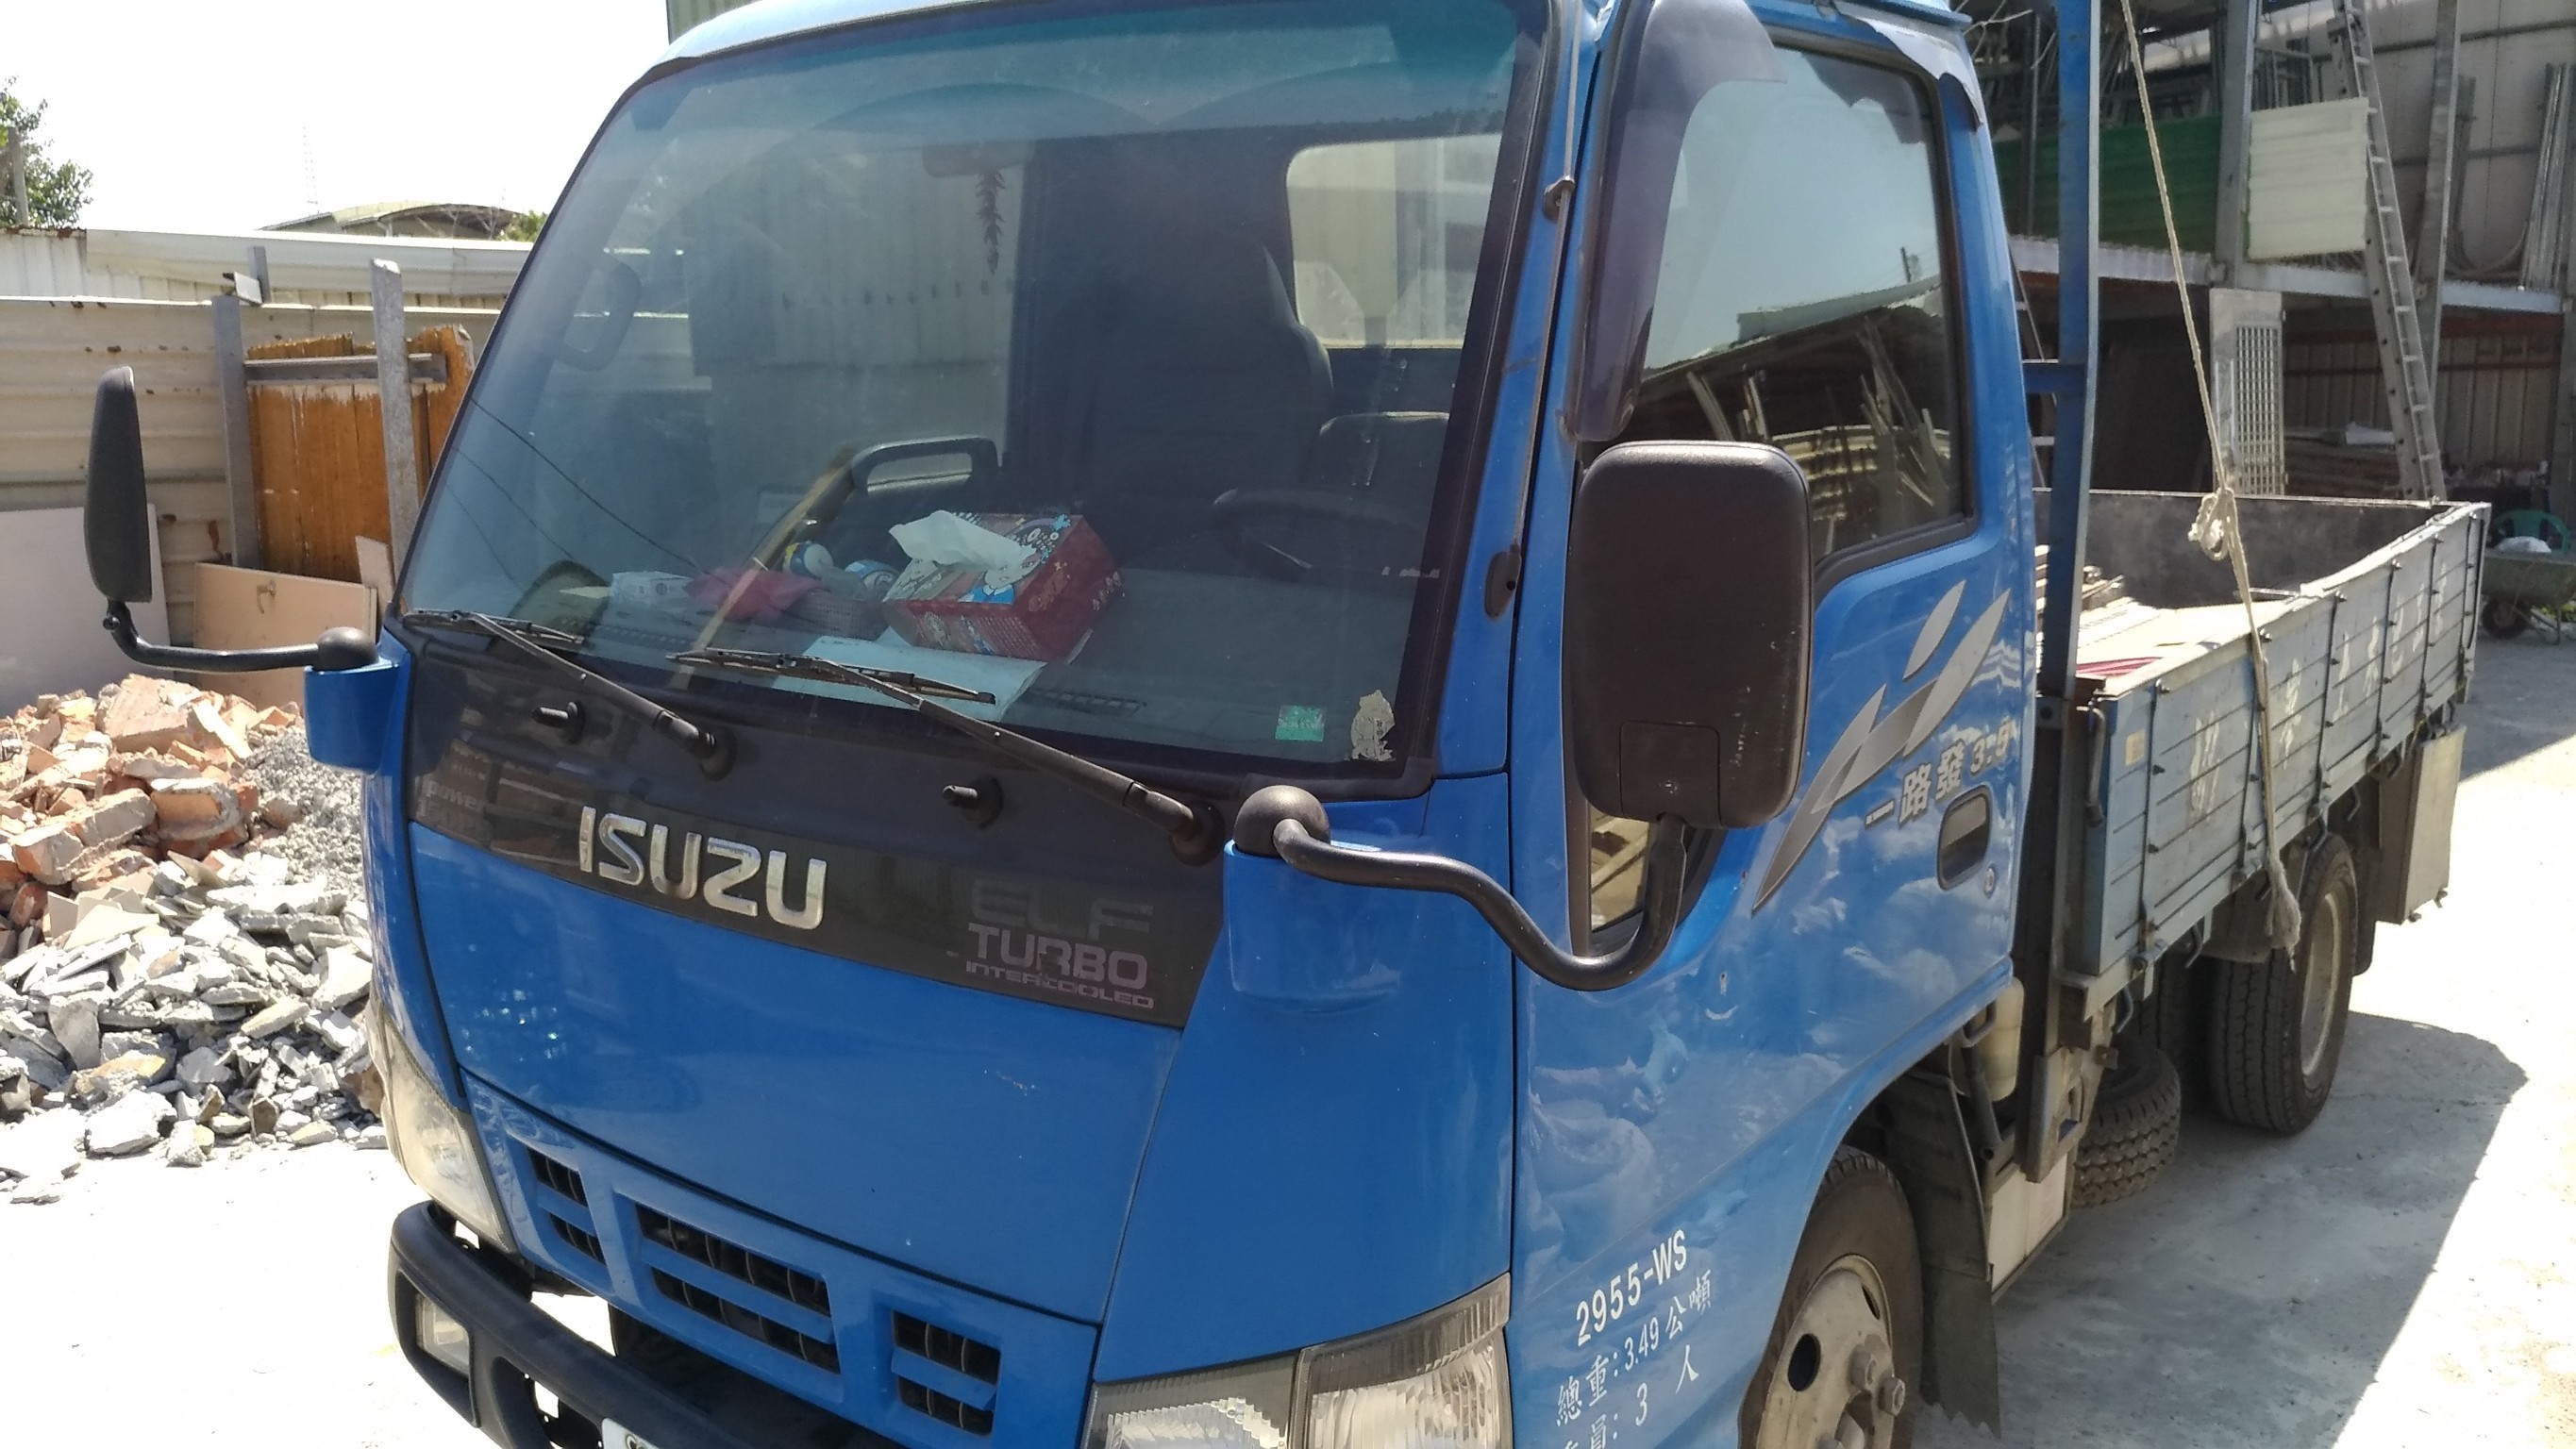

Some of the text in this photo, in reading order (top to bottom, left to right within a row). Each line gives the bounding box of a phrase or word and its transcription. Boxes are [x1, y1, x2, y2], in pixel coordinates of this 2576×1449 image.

[1865, 741, 1965, 825] 一路發
[578, 806, 828, 930] ISUZU
[971, 877, 1154, 941] ELF
[965, 960, 1154, 1009] INTERCOOLED
[968, 923, 1147, 990] TURBO
[1576, 1229, 1687, 1346] 2955-WS
